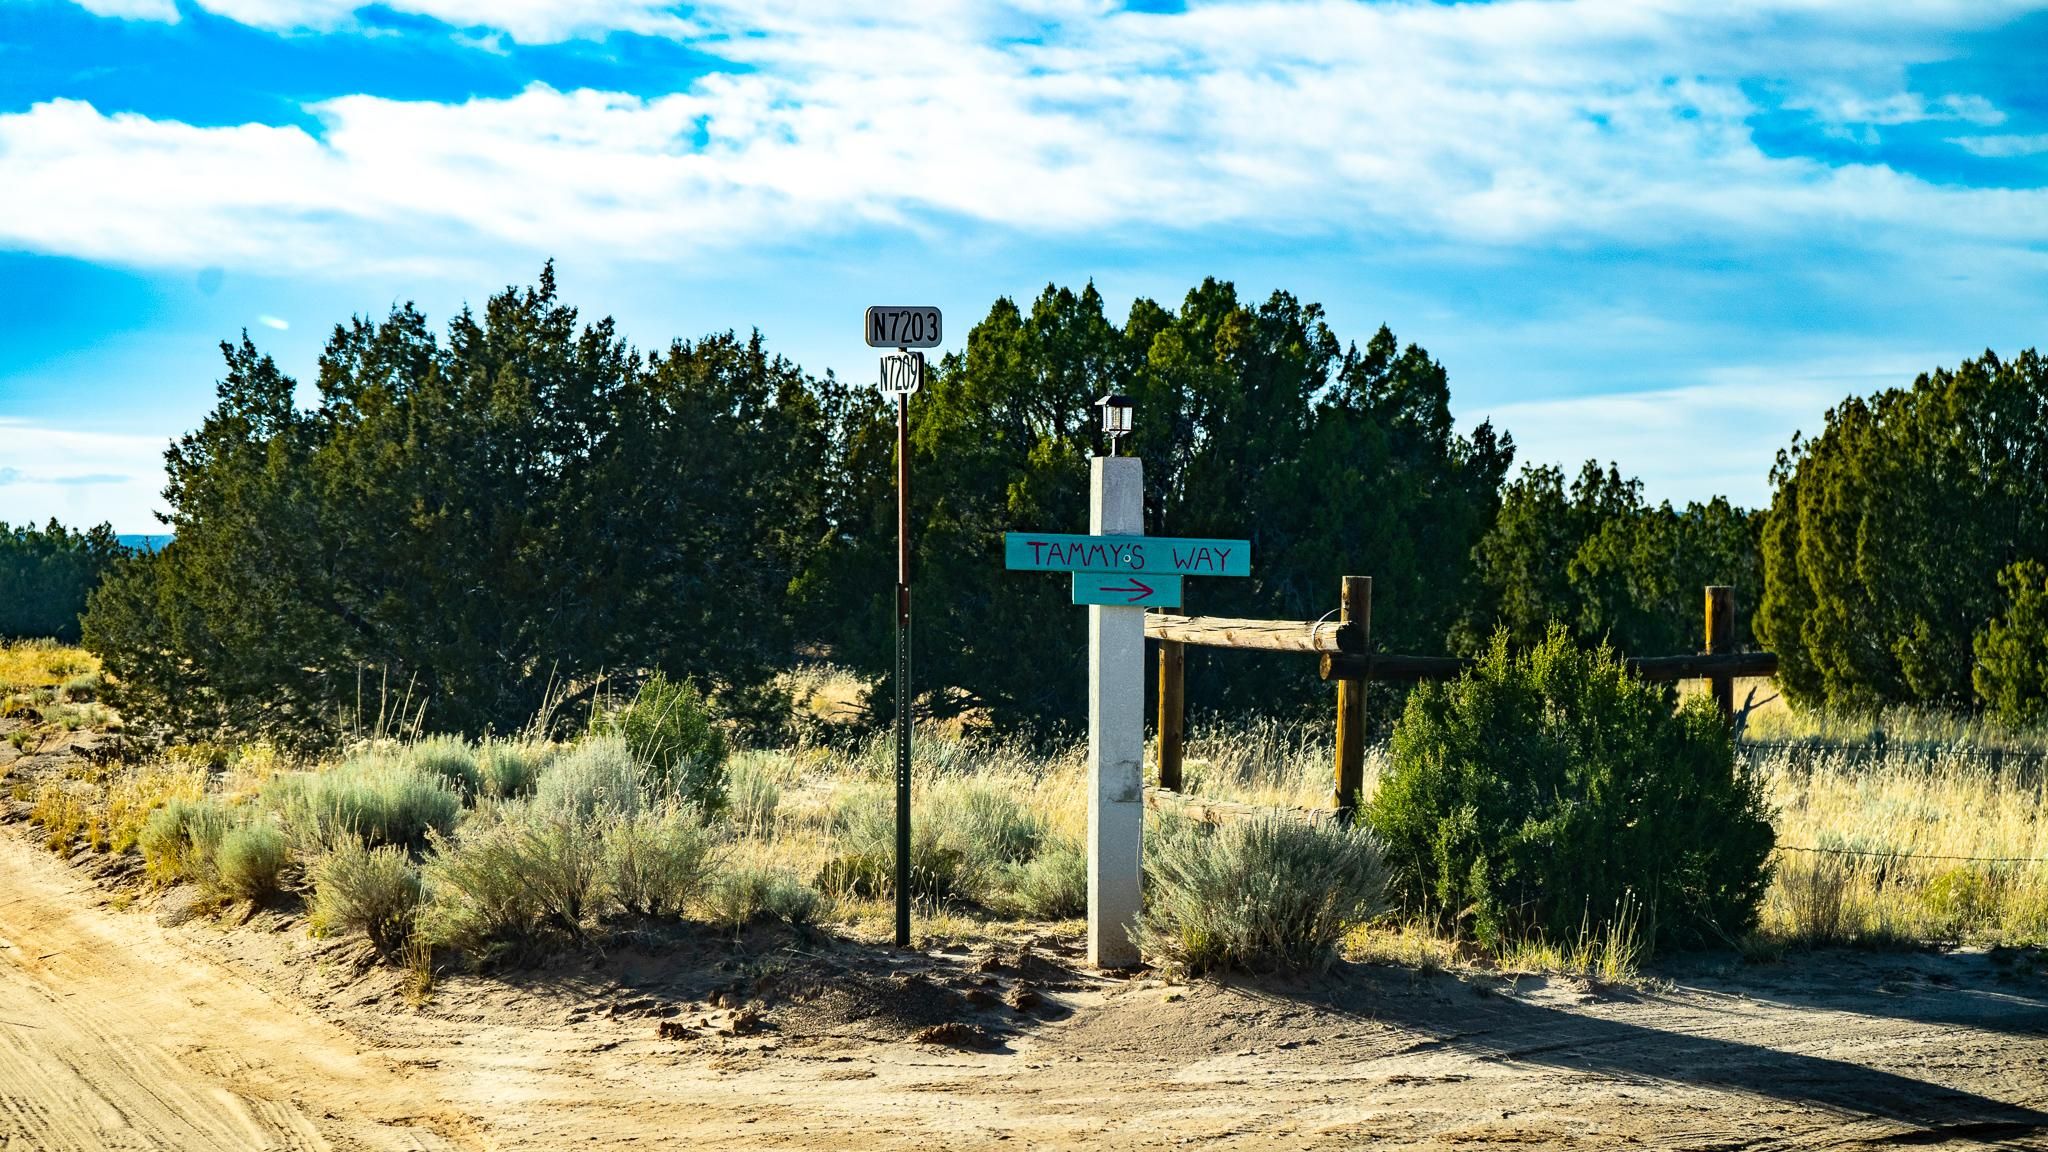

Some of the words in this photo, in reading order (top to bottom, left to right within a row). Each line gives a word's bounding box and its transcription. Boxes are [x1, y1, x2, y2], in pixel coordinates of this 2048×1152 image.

[874, 311, 938, 343] N7203
[880, 354, 918, 391] N7209
[1026, 541, 1145, 570] TAMMY'S
[1172, 547, 1232, 572] WAY
